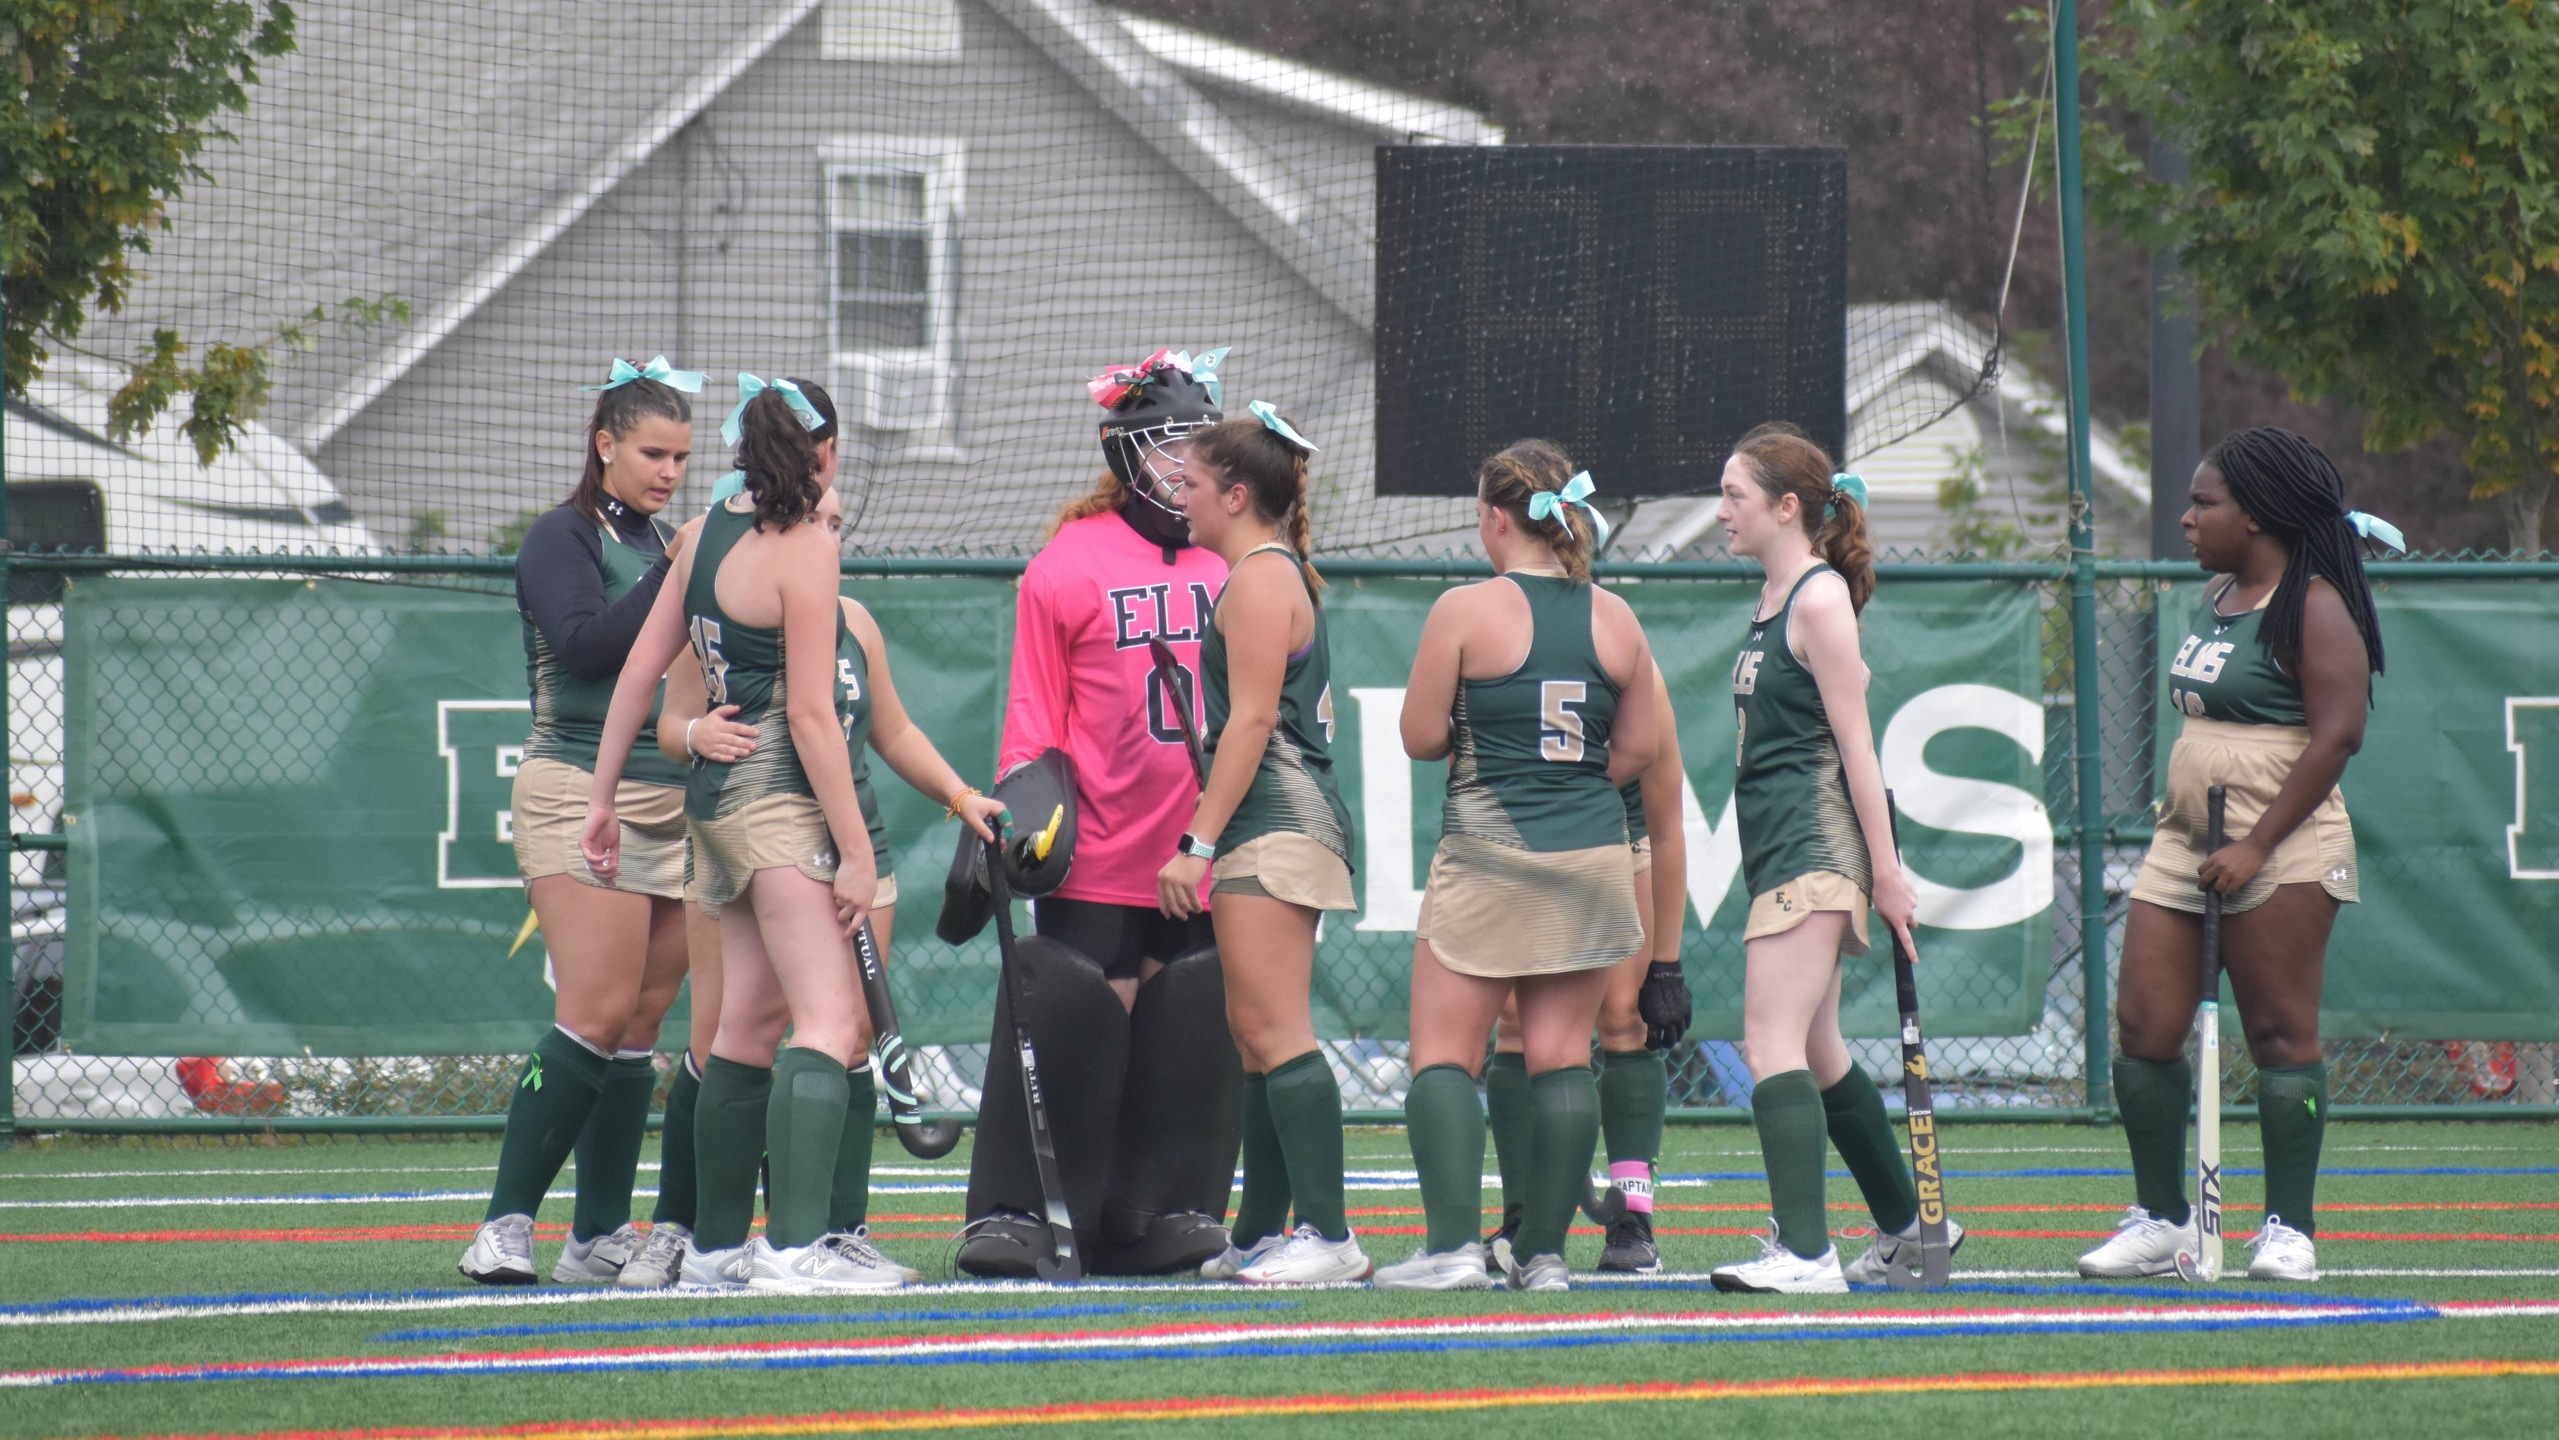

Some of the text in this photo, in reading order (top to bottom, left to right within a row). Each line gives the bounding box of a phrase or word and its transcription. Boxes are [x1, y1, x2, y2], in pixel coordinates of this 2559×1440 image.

[1108, 582, 1227, 651] ELM
[690, 615, 729, 704] 15
[2170, 634, 2235, 684] ELMS
[1541, 681, 1586, 762] 5
[1023, 1038, 1040, 1104] RITUL
[1910, 1115, 1944, 1225] GRACE
[2201, 1159, 2221, 1240] STX
